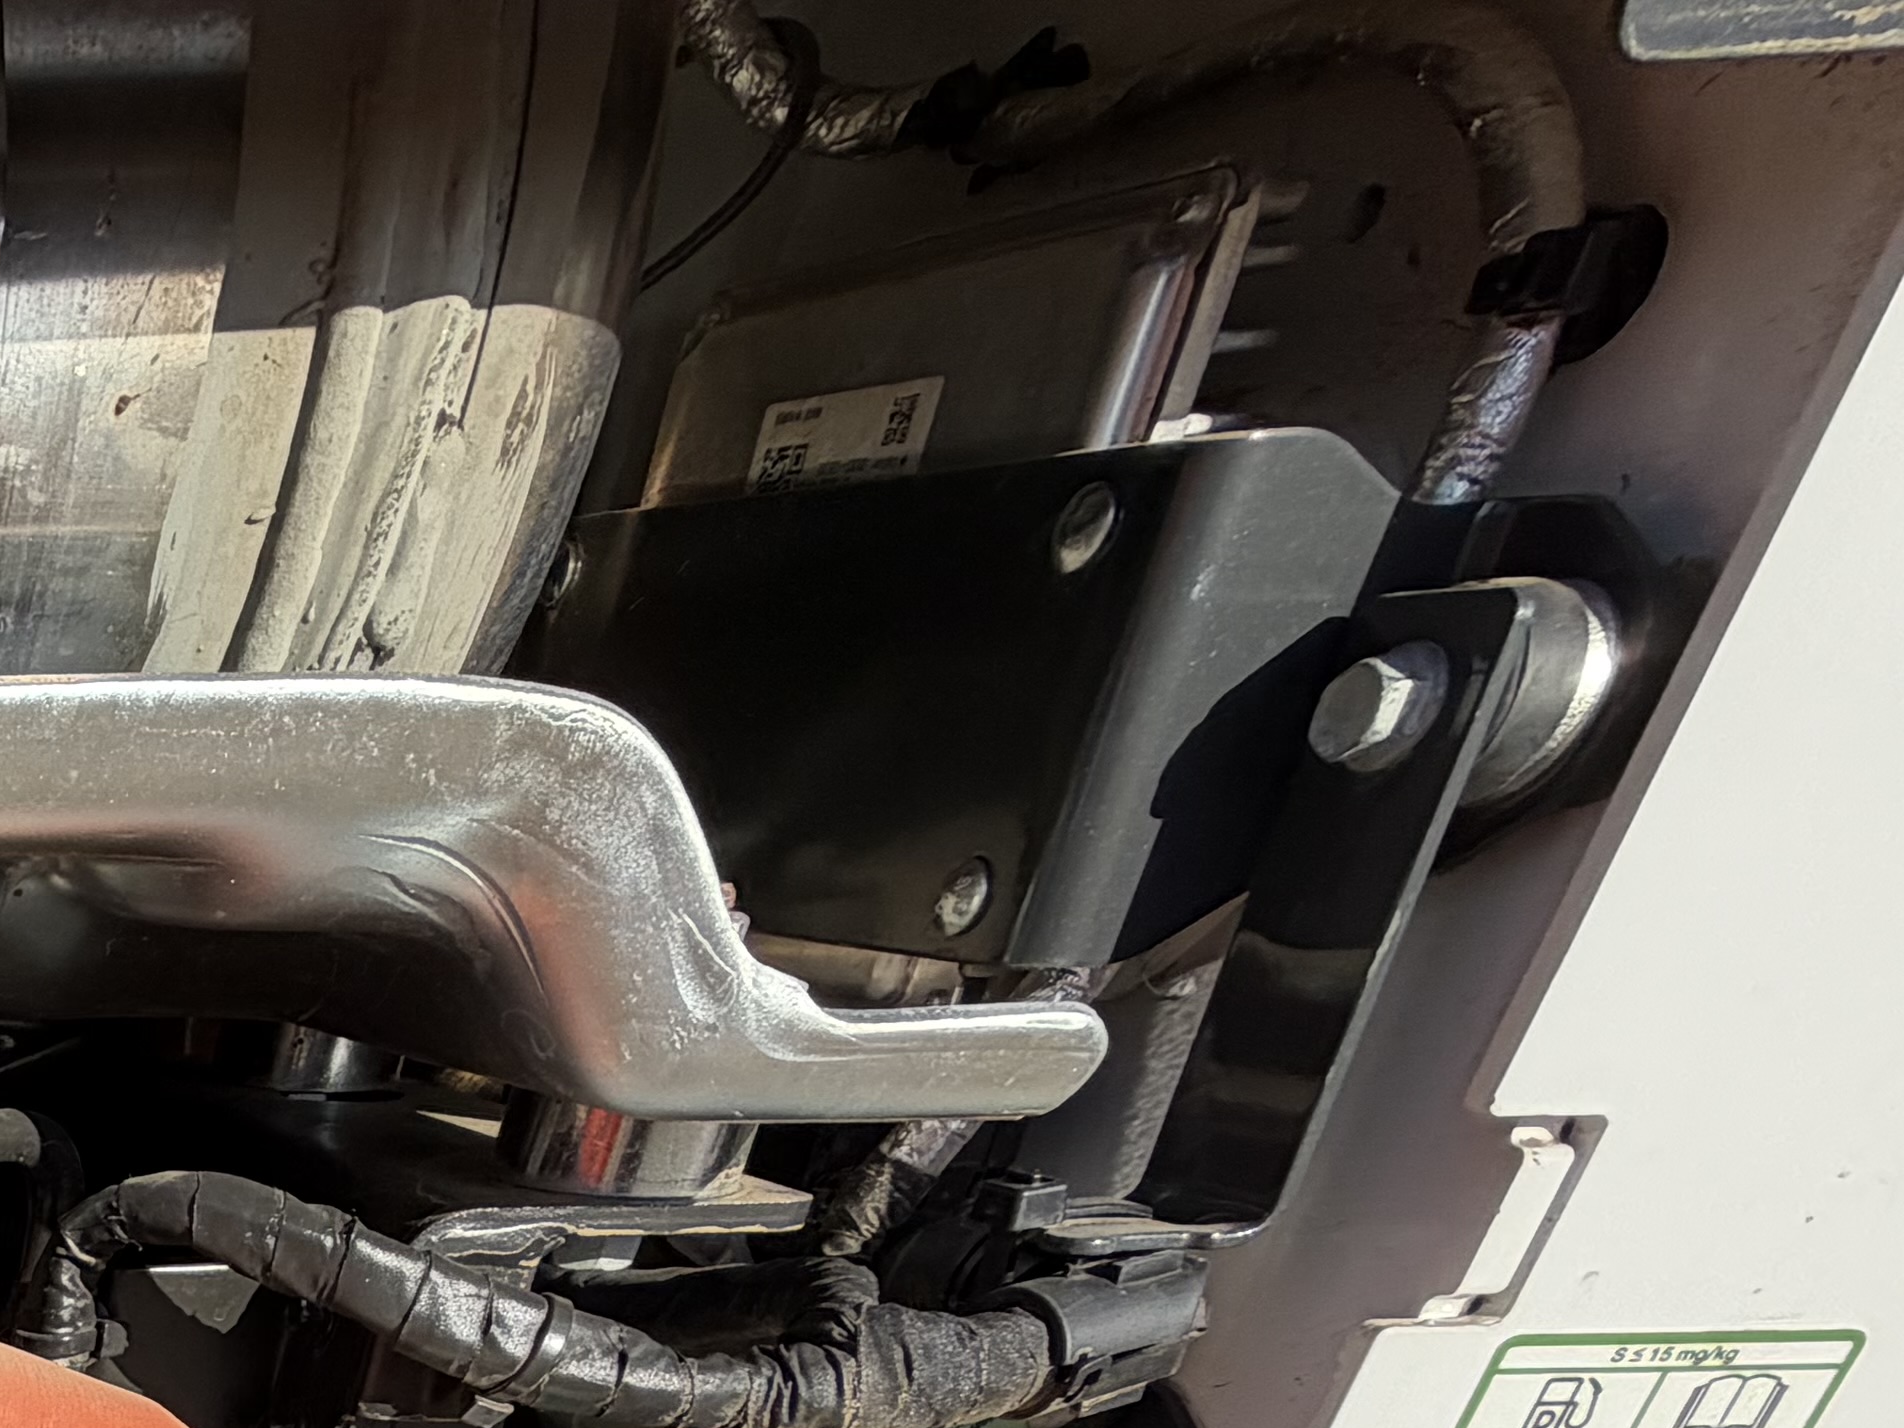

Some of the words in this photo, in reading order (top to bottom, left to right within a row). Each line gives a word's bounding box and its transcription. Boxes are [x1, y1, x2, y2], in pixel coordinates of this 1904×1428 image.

[1610, 1347, 1626, 1363] S
[1649, 1346, 1672, 1362] 15
[1675, 1346, 1741, 1366] mg/kg
